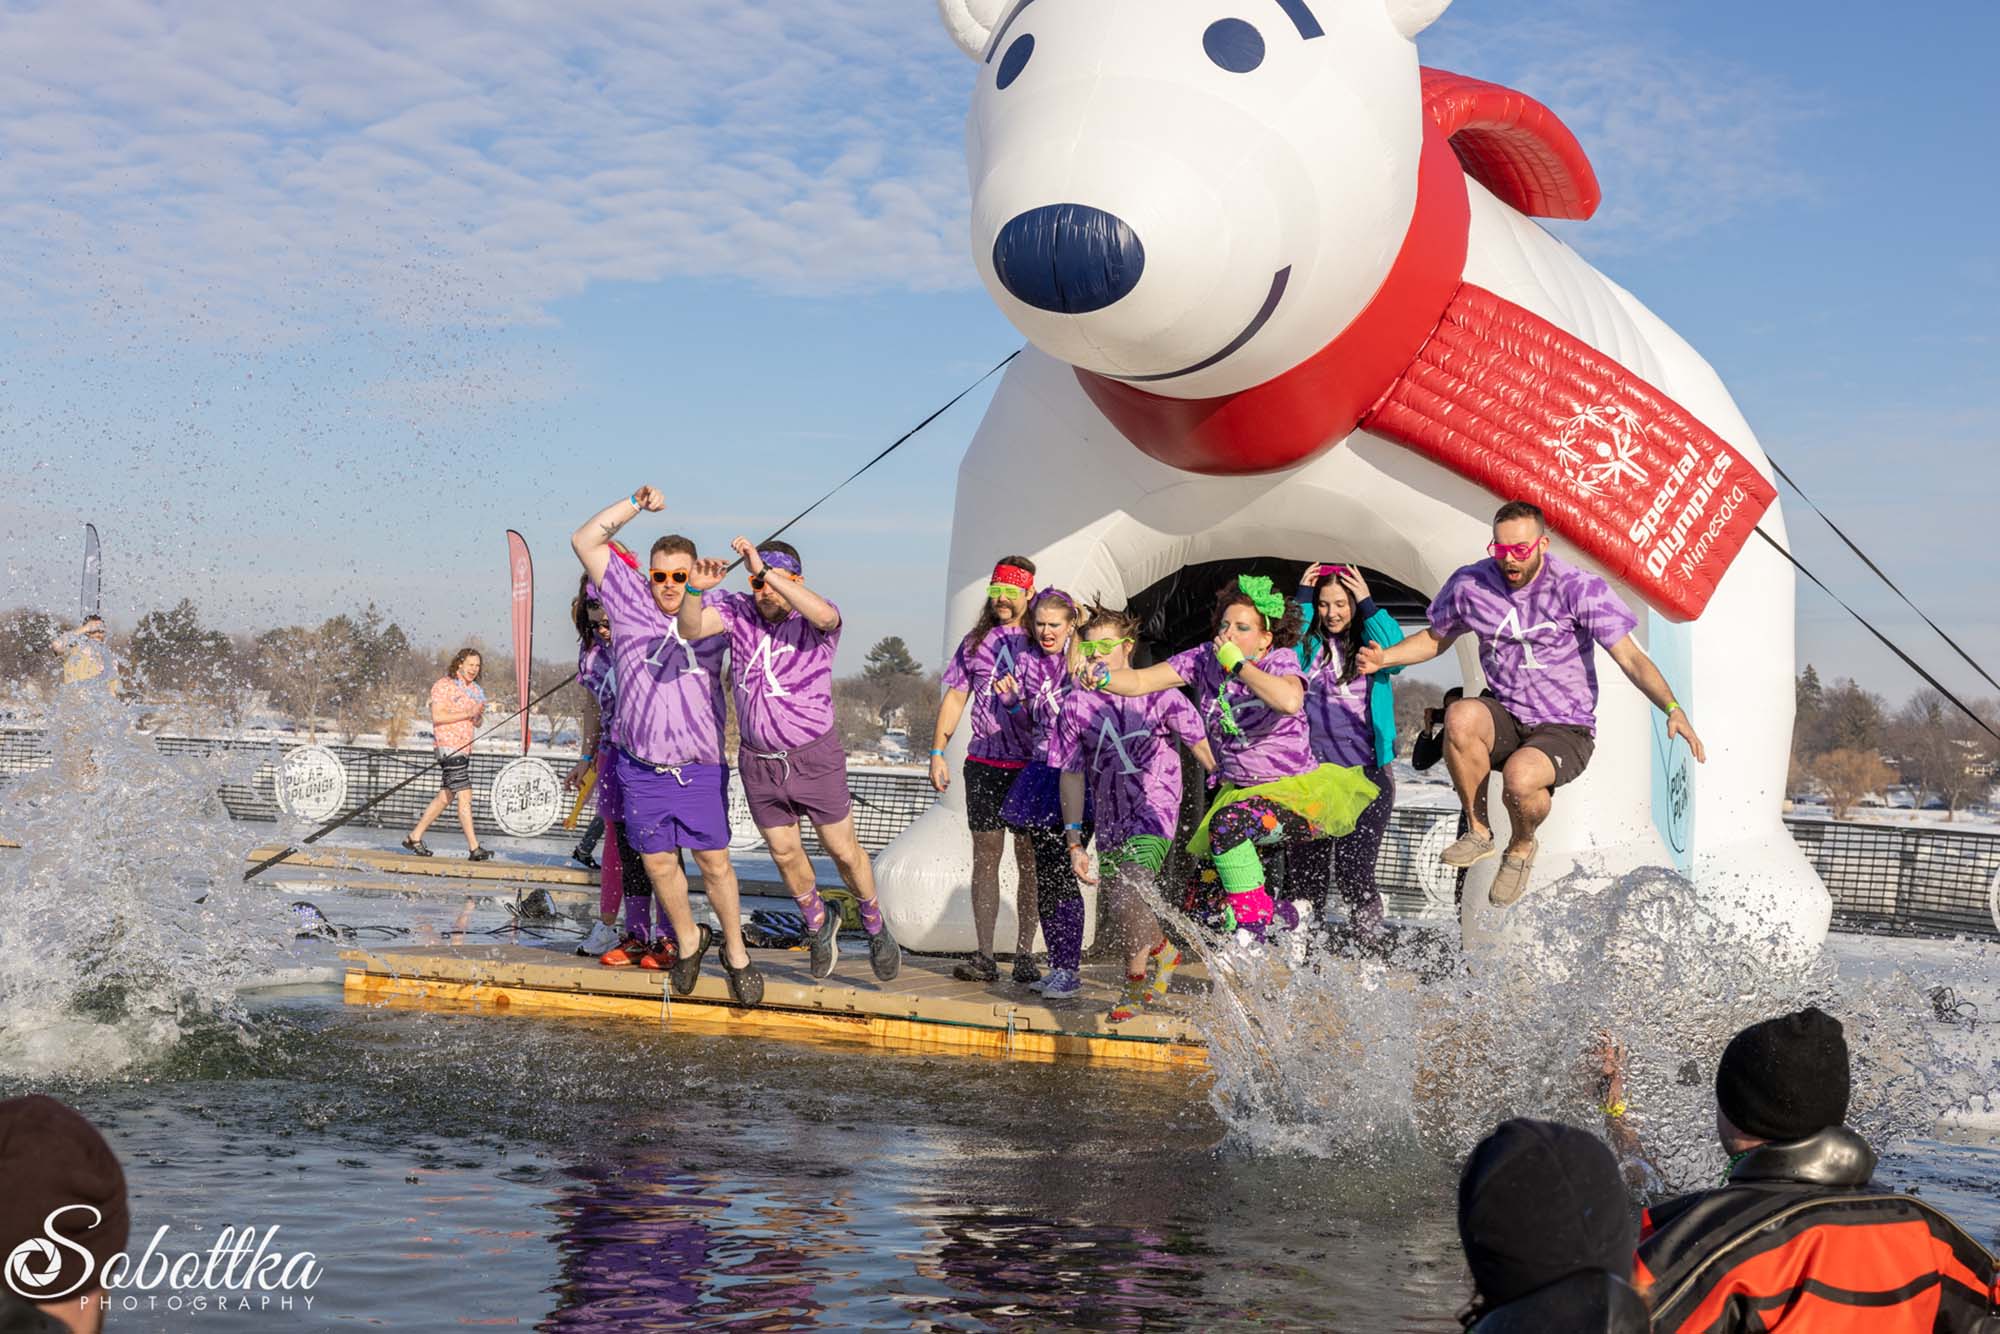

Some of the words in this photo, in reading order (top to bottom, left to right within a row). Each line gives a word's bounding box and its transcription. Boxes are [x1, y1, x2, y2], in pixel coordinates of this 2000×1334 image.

[1629, 441, 1701, 549] Special
[1646, 450, 1733, 578] Olympics
[1680, 485, 1745, 580] Minnesota
